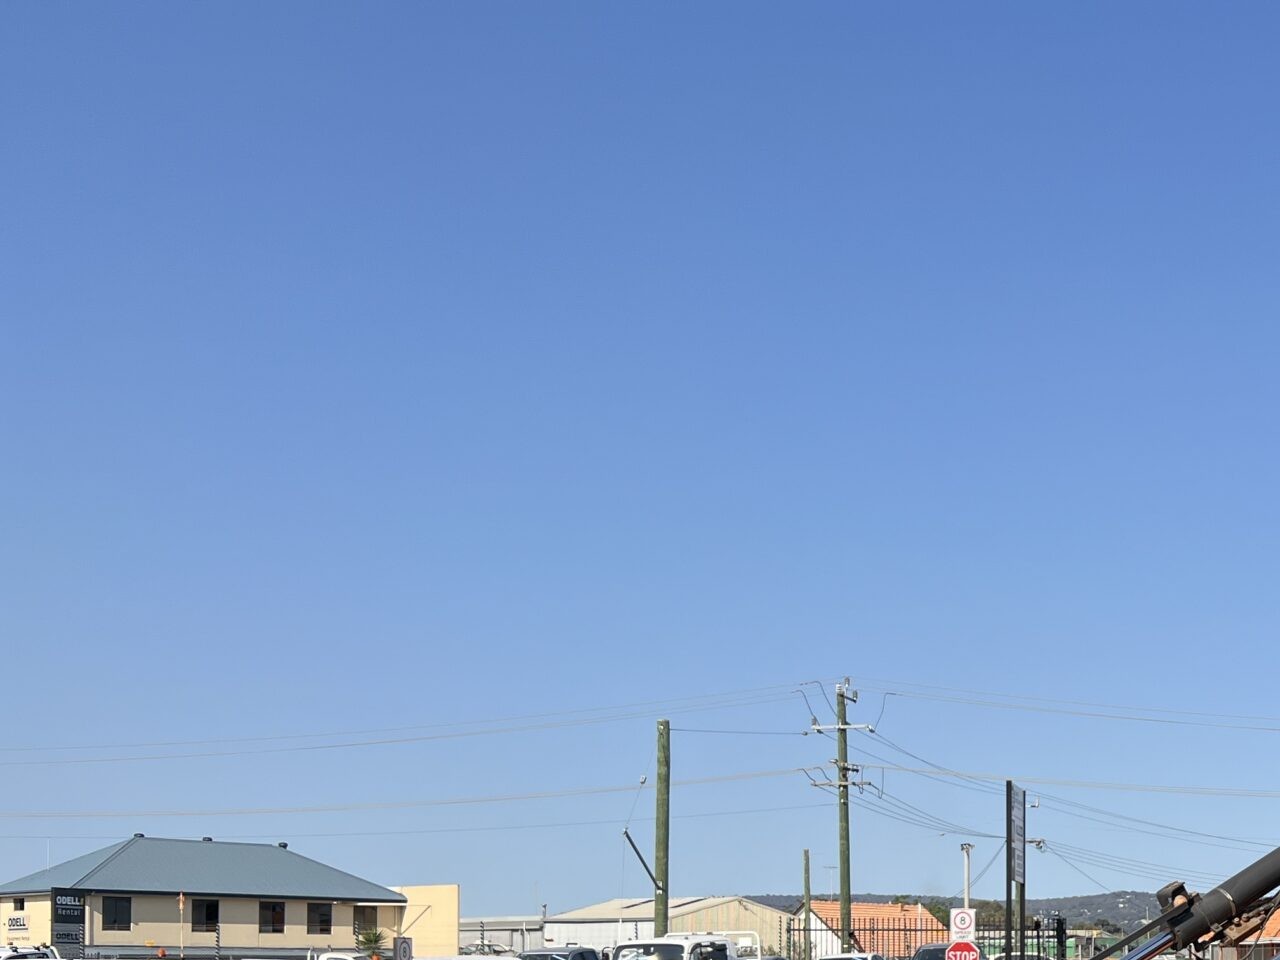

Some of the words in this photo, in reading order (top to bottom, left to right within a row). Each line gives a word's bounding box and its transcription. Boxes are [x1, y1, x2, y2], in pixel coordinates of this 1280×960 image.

[56, 896, 80, 905] ODELL
[57, 908, 81, 916] Rental
[8, 917, 26, 927] ODELL
[959, 916, 966, 925] 8
[55, 932, 80, 941] ODELL
